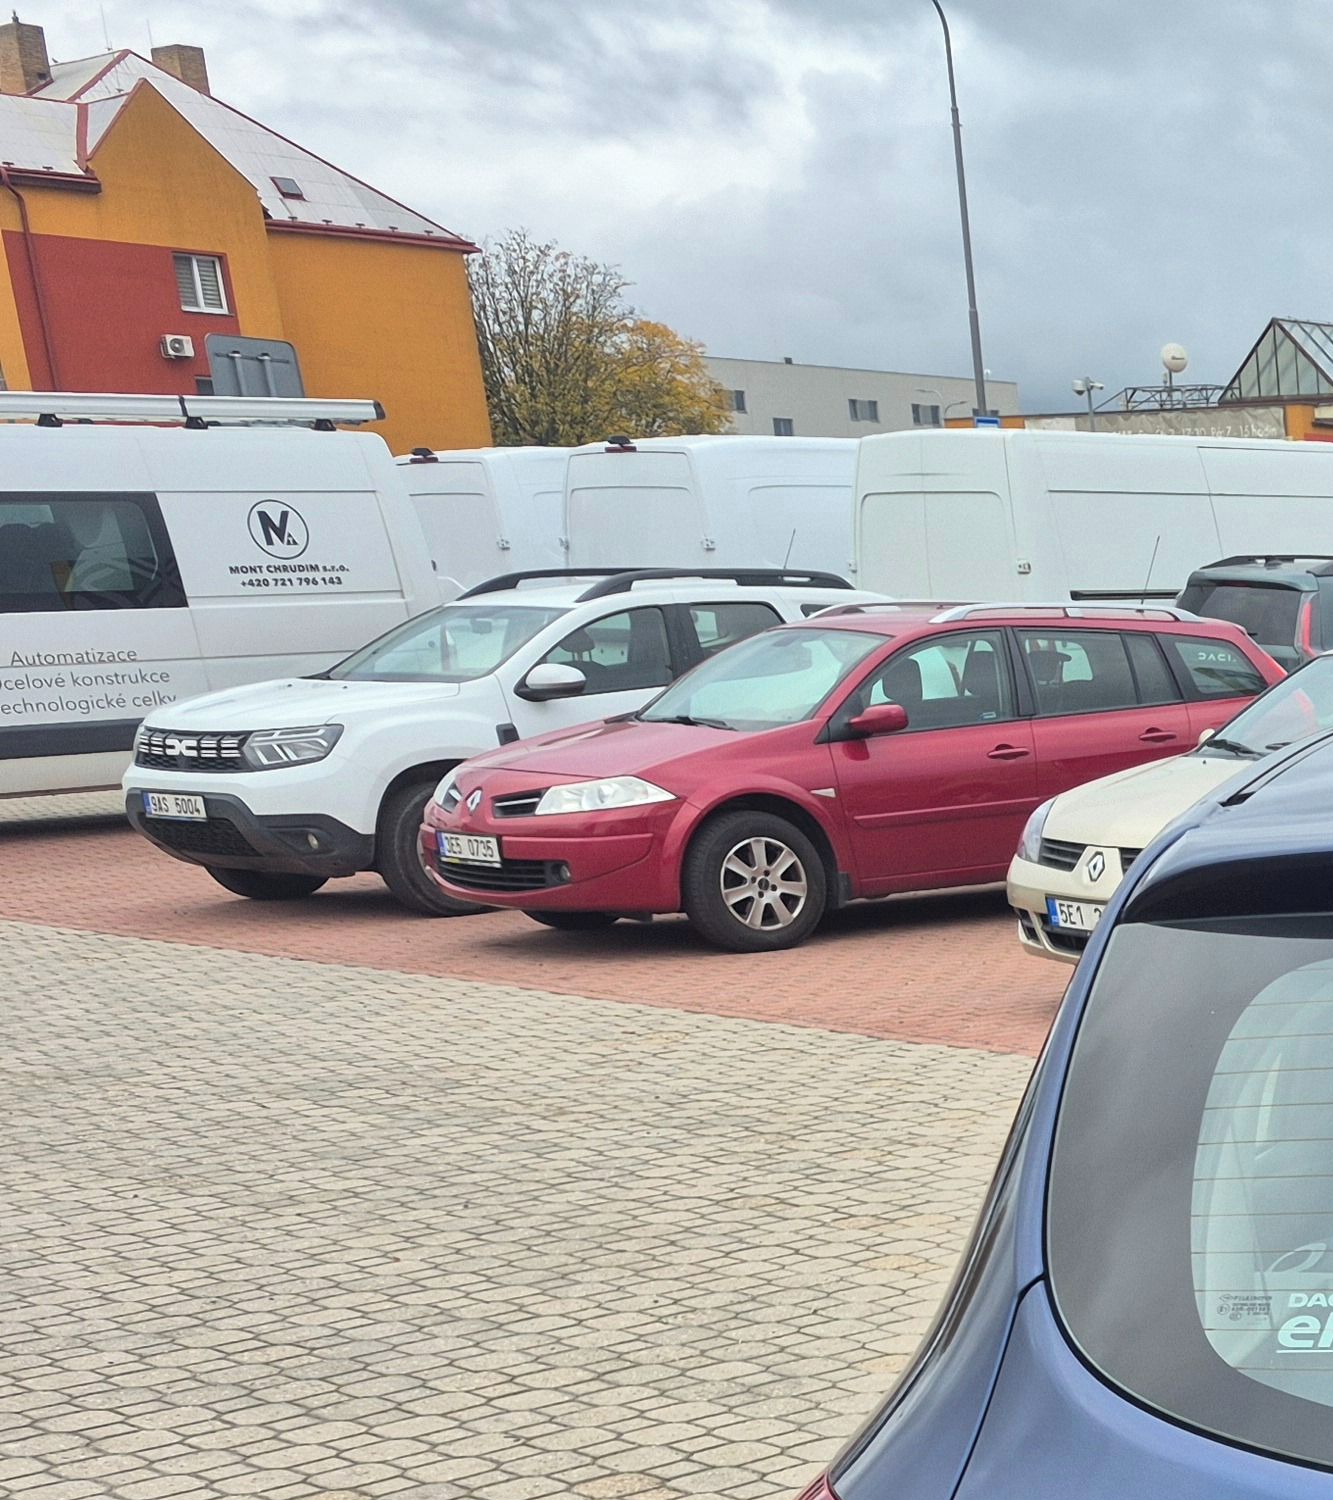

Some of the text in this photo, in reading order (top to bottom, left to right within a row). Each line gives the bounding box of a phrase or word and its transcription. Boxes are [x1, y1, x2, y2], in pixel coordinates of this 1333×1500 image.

[229, 564, 350, 575] MONT CHRUDIM s.r.o.
[240, 576, 343, 588] +420 721 796 143
[10, 648, 138, 667] Automatizace
[0, 668, 170, 691] celové konstrukce
[151, 795, 201, 815] 9AS 5004
[1058, 903, 1085, 927] 5E1
